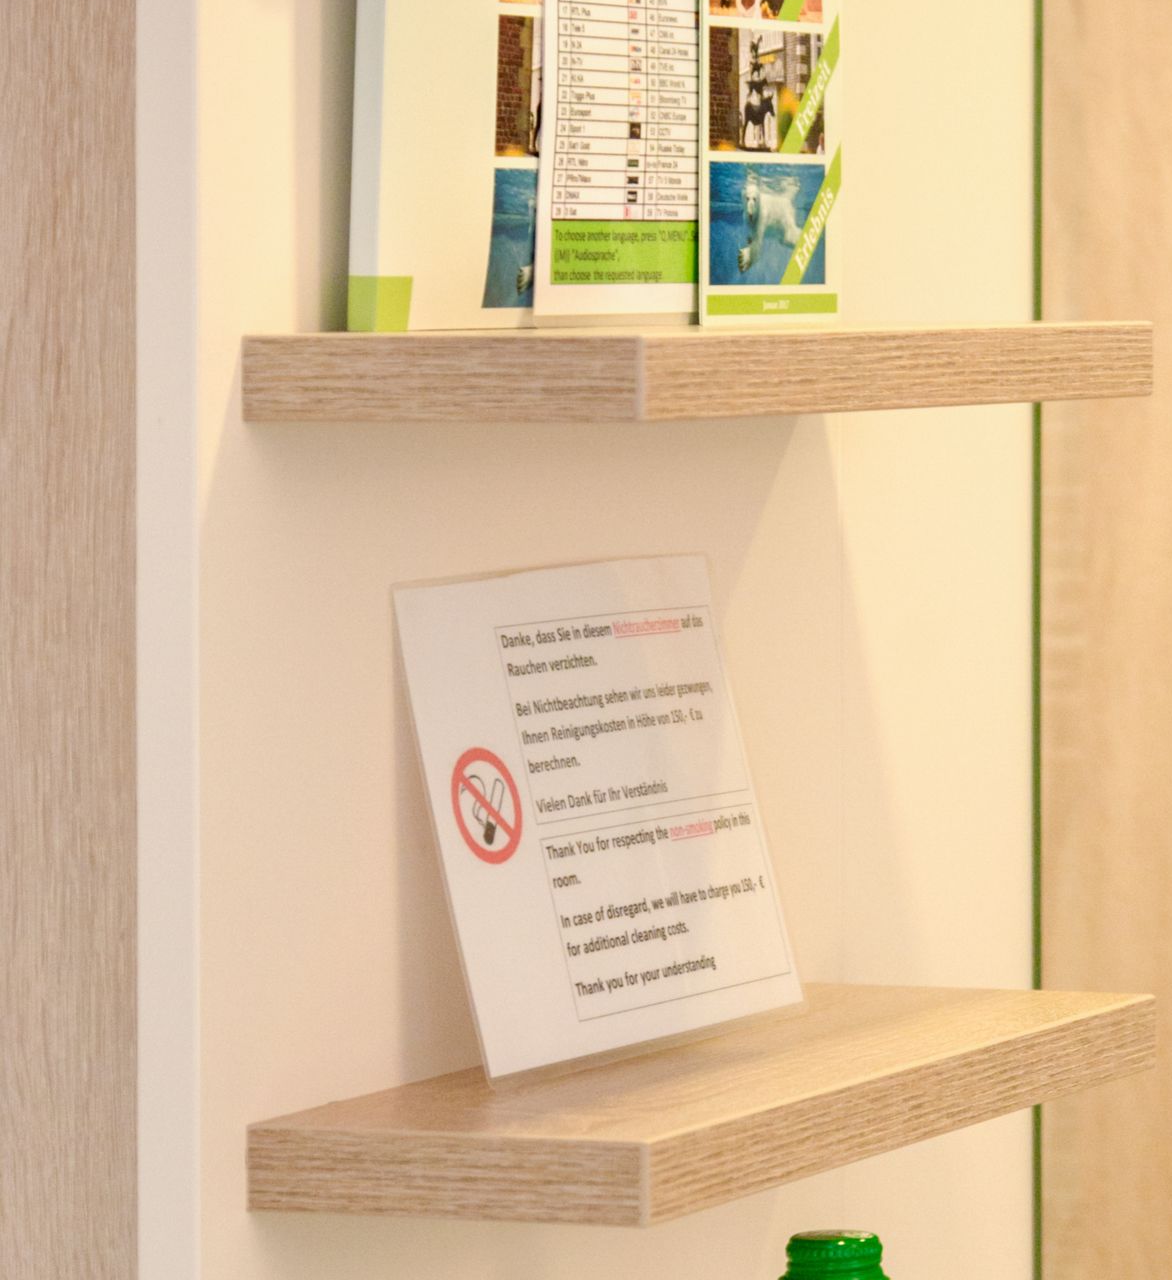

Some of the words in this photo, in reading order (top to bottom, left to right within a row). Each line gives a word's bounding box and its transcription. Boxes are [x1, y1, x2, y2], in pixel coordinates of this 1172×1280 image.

[795, 60, 831, 137] Freizeit
[794, 186, 834, 271] Erlebnis
[501, 631, 535, 649] Danke,
[536, 629, 556, 644] dass
[558, 627, 571, 642] Sie
[573, 625, 581, 639] in
[583, 623, 612, 639] diesem
[507, 660, 547, 677] Rauchen
[549, 654, 598, 671] verzichten.
[516, 702, 531, 717] Bei
[533, 693, 605, 713] Nichtbeachtung
[605, 687, 629, 705] sehen
[630, 686, 641, 700] wir
[644, 686, 656, 699] uns
[656, 683, 676, 698] leider
[522, 730, 549, 745] Ihnen
[552, 719, 627, 741] Reinigungskosten
[628, 716, 636, 729] in
[637, 712, 656, 728] Höhe
[658, 713, 670, 726] von
[528, 755, 581, 774] berechnen.
[536, 797, 567, 814] Vielen
[568, 792, 592, 810] Dank
[593, 790, 607, 805] für
[609, 787, 621, 801] Ihr
[623, 780, 668, 799] Verständnis
[546, 841, 576, 860] Thank
[576, 837, 595, 854] You
[596, 835, 610, 851] for
[612, 828, 655, 849] respecting
[655, 827, 668, 840] the
[713, 815, 732, 833] policy
[732, 813, 739, 826] in
[740, 811, 751, 825] this
[552, 873, 581, 889] room.
[560, 914, 570, 928] In
[573, 909, 593, 926] case
[595, 908, 605, 922] of
[607, 899, 650, 921] disregard,
[651, 898, 664, 911] we
[665, 892, 679, 907] will
[680, 890, 698, 906] have
[698, 888, 707, 901] to
[708, 884, 729, 900] charge
[730, 883, 741, 898] you
[759, 875, 765, 889] €
[567, 941, 581, 958] for
[583, 930, 630, 954] additional
[631, 923, 667, 945] cleaning
[667, 920, 690, 937] costs.
[575, 978, 605, 998] Thank
[605, 975, 624, 993] you
[625, 971, 638, 987] for
[640, 967, 660, 986] your
[662, 954, 717, 978] understanding
